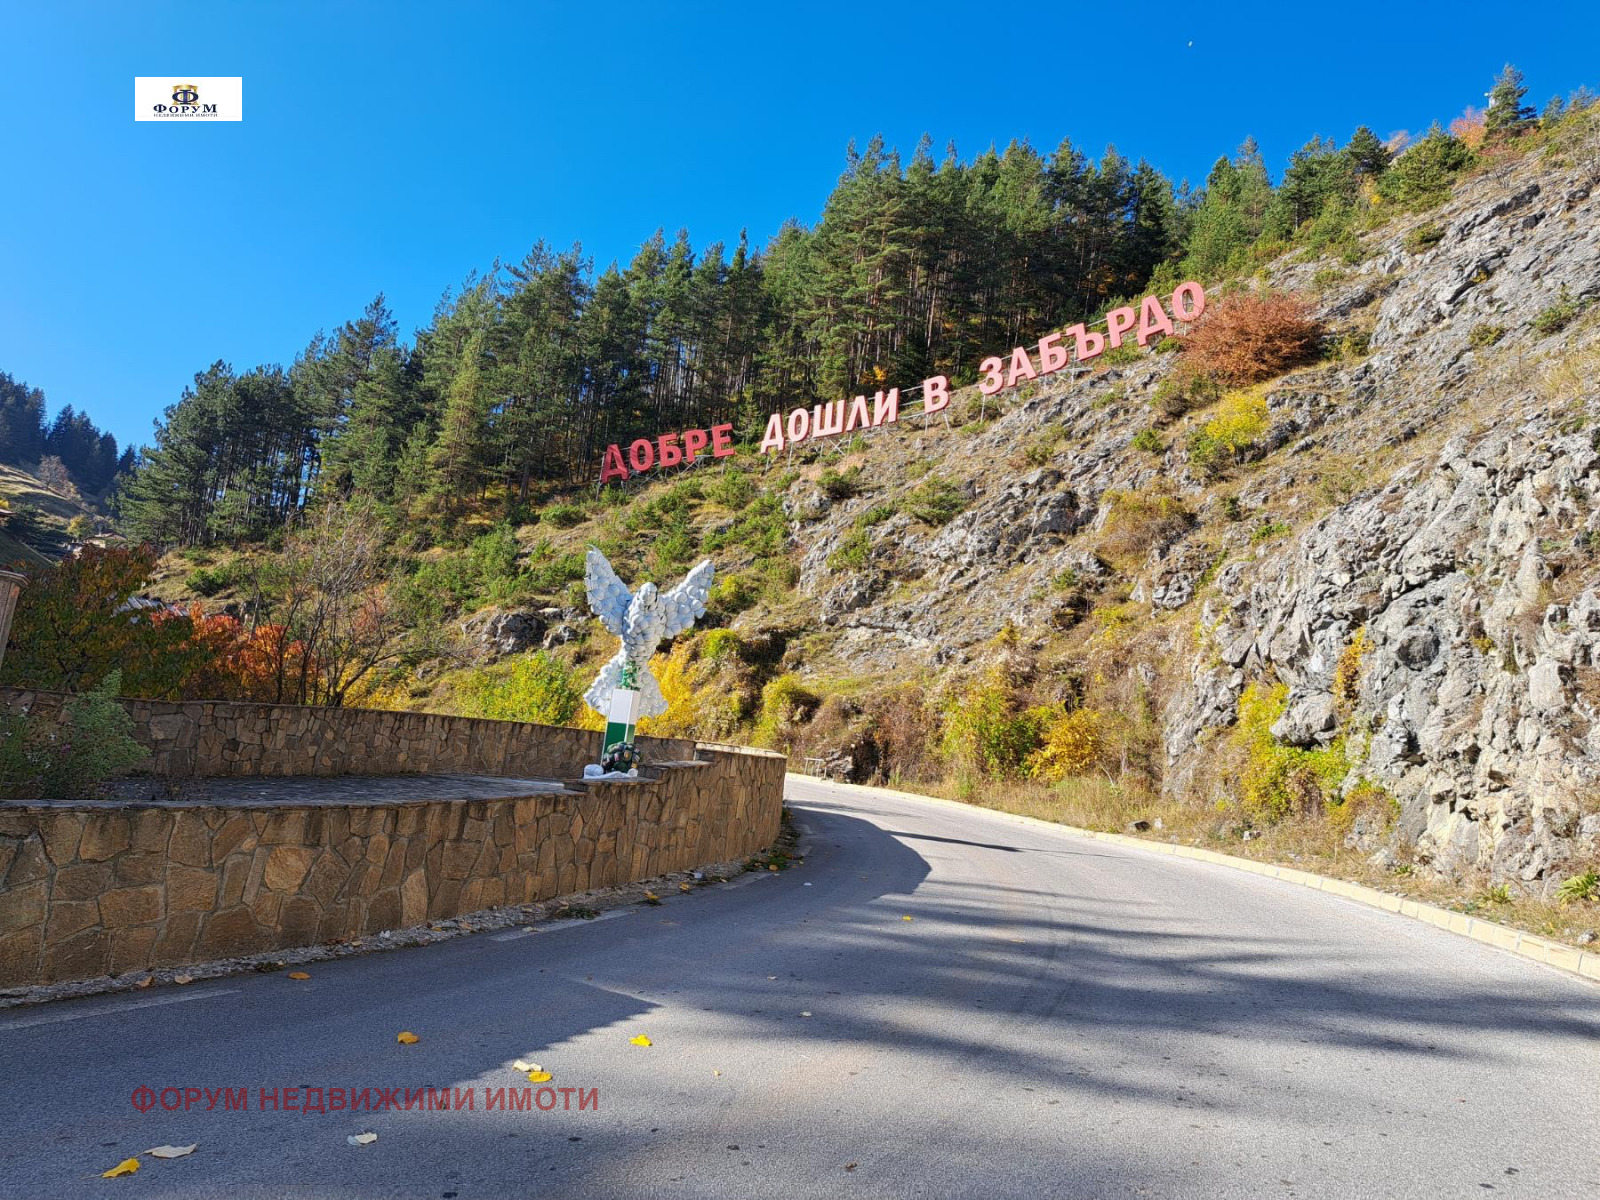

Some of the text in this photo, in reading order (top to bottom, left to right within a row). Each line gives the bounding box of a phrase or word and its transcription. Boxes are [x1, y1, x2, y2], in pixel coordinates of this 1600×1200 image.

[600, 281, 1206, 484] ДОБРЕ ДОШЛИ В ЗАБЪРДО
